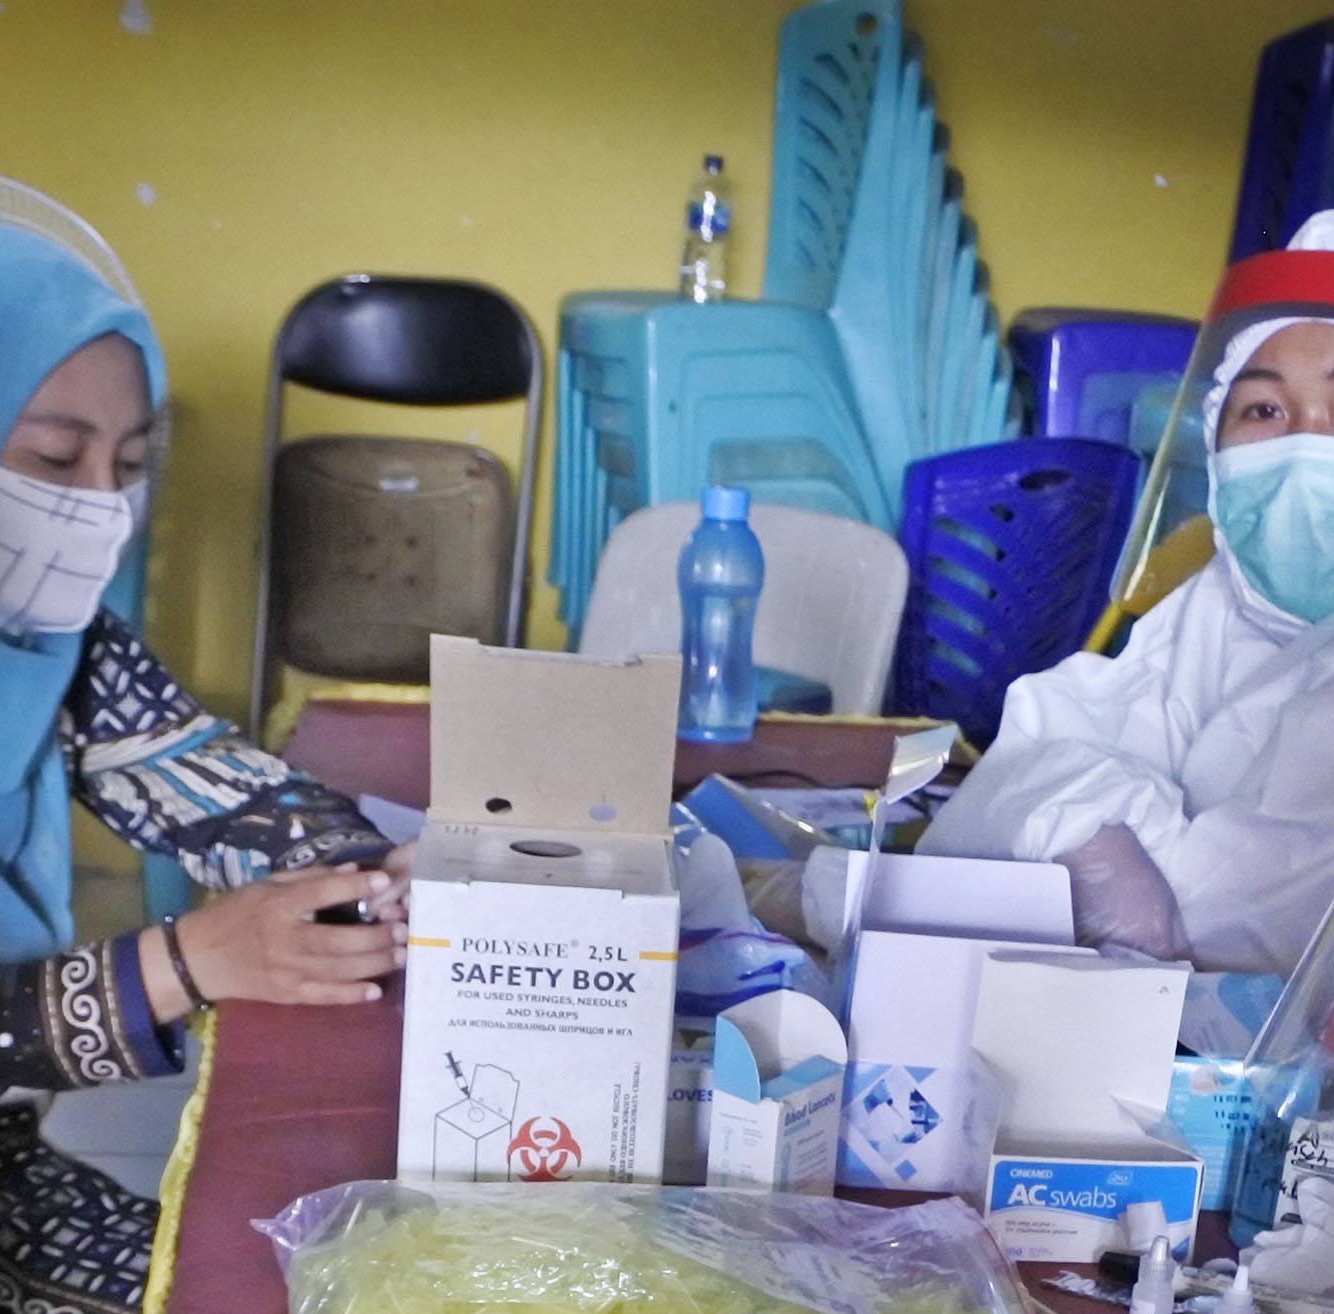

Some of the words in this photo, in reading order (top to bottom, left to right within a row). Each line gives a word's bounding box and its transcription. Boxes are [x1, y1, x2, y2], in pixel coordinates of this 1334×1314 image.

[451, 962, 562, 988] SAFETY
[572, 969, 636, 993] BOX
[457, 989, 480, 999] FOR
[484, 991, 514, 1002] USED
[517, 993, 575, 1005] SYRINGES,
[577, 996, 628, 1008] NEEDLES
[505, 1007, 532, 1017] AND
[535, 1009, 579, 1020] SHARPS
[1007, 1183, 1048, 1207] AC
[1049, 1185, 1117, 1209] swabs
